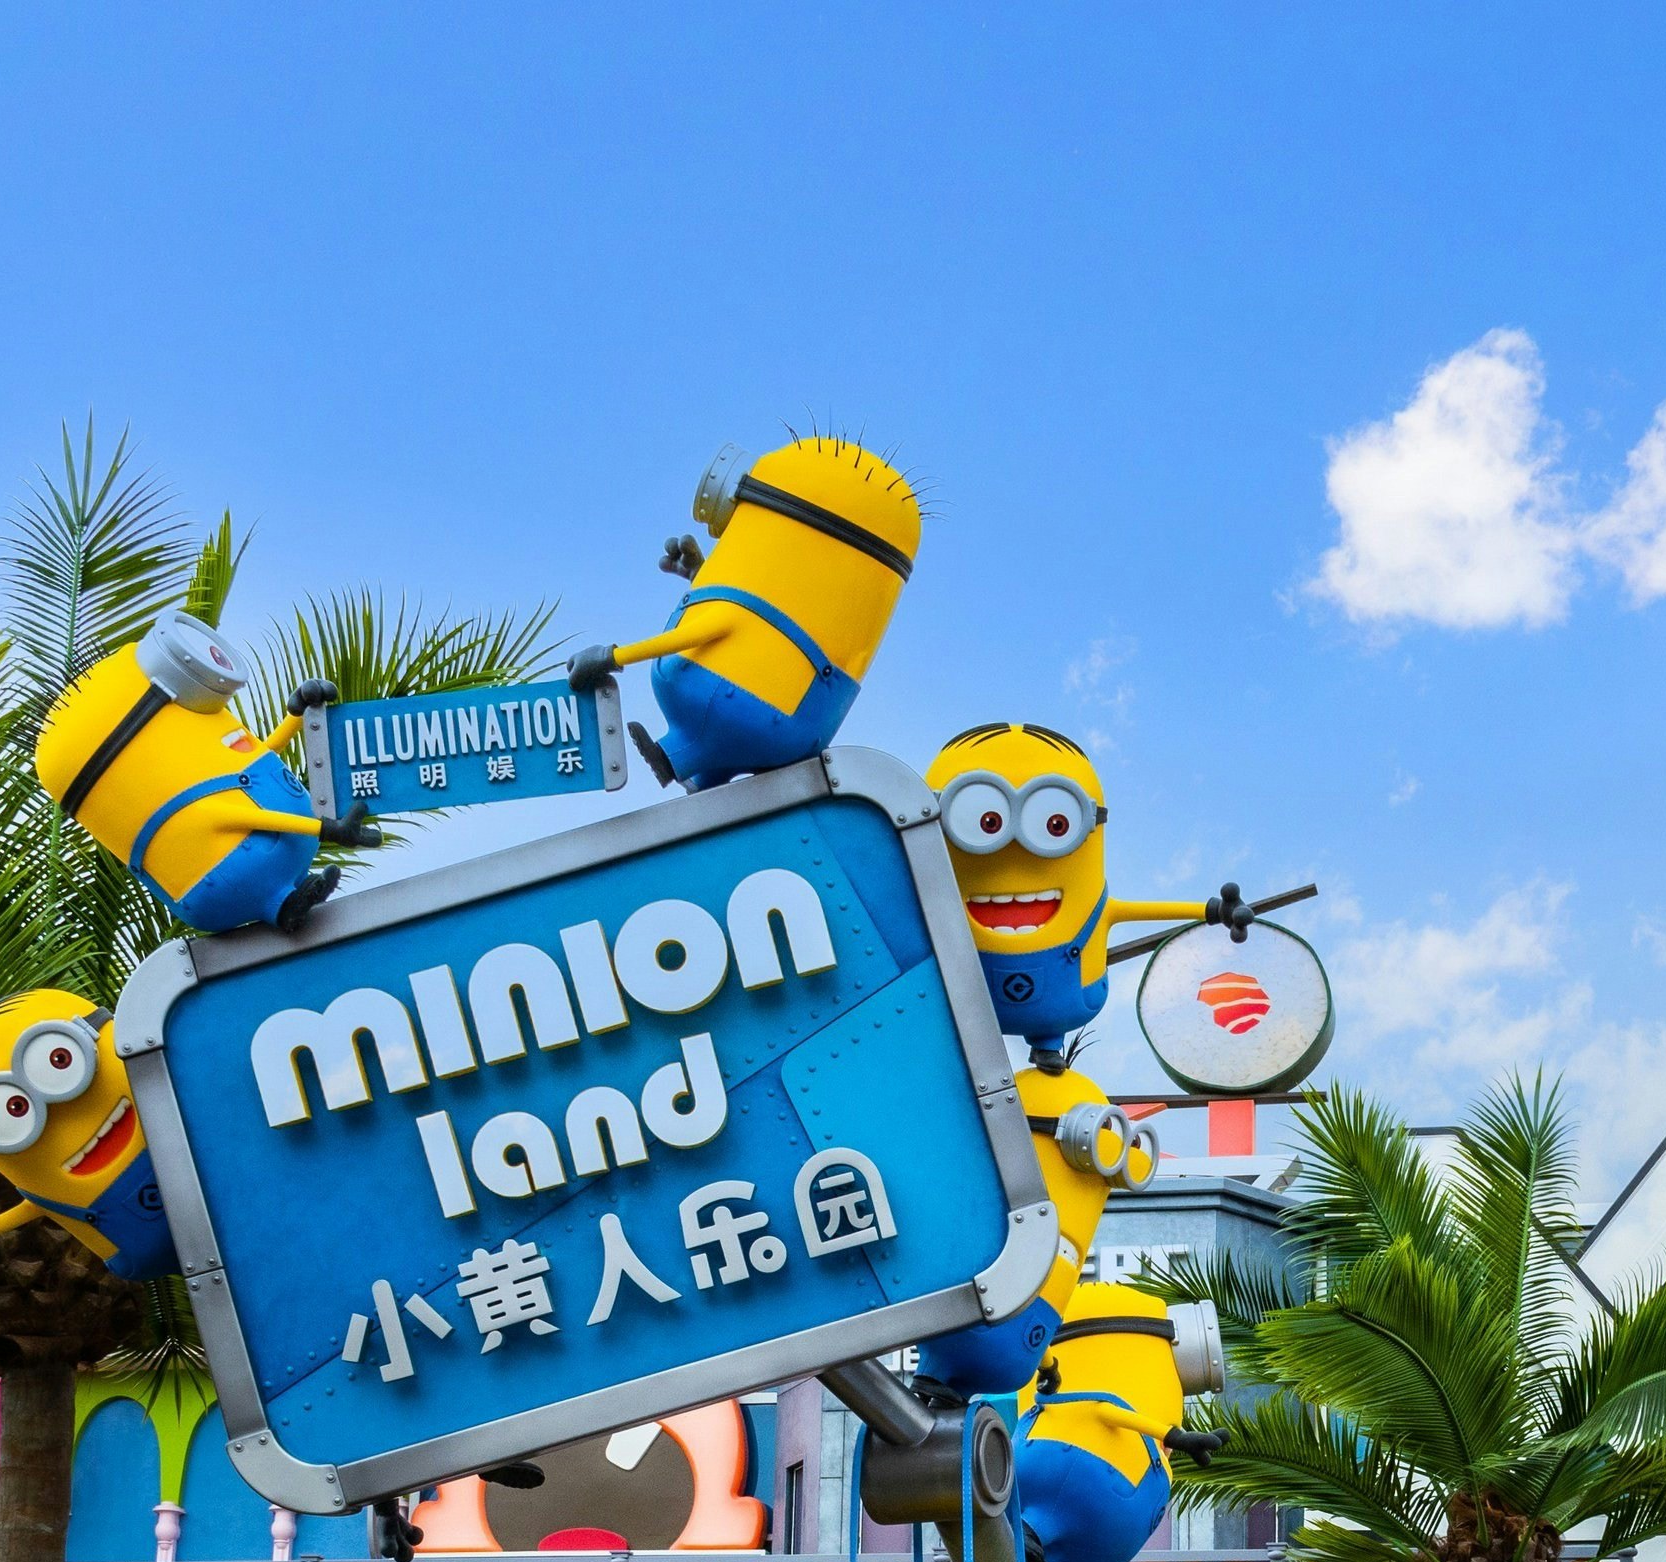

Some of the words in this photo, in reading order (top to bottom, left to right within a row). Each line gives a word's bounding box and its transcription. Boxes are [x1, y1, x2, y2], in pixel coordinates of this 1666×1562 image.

[344, 694, 581, 767] ILLUMINATION
[350, 747, 584, 797] 照明娱乐
[416, 1031, 728, 1220] land
[339, 1146, 897, 1384] 小黄人乐园
